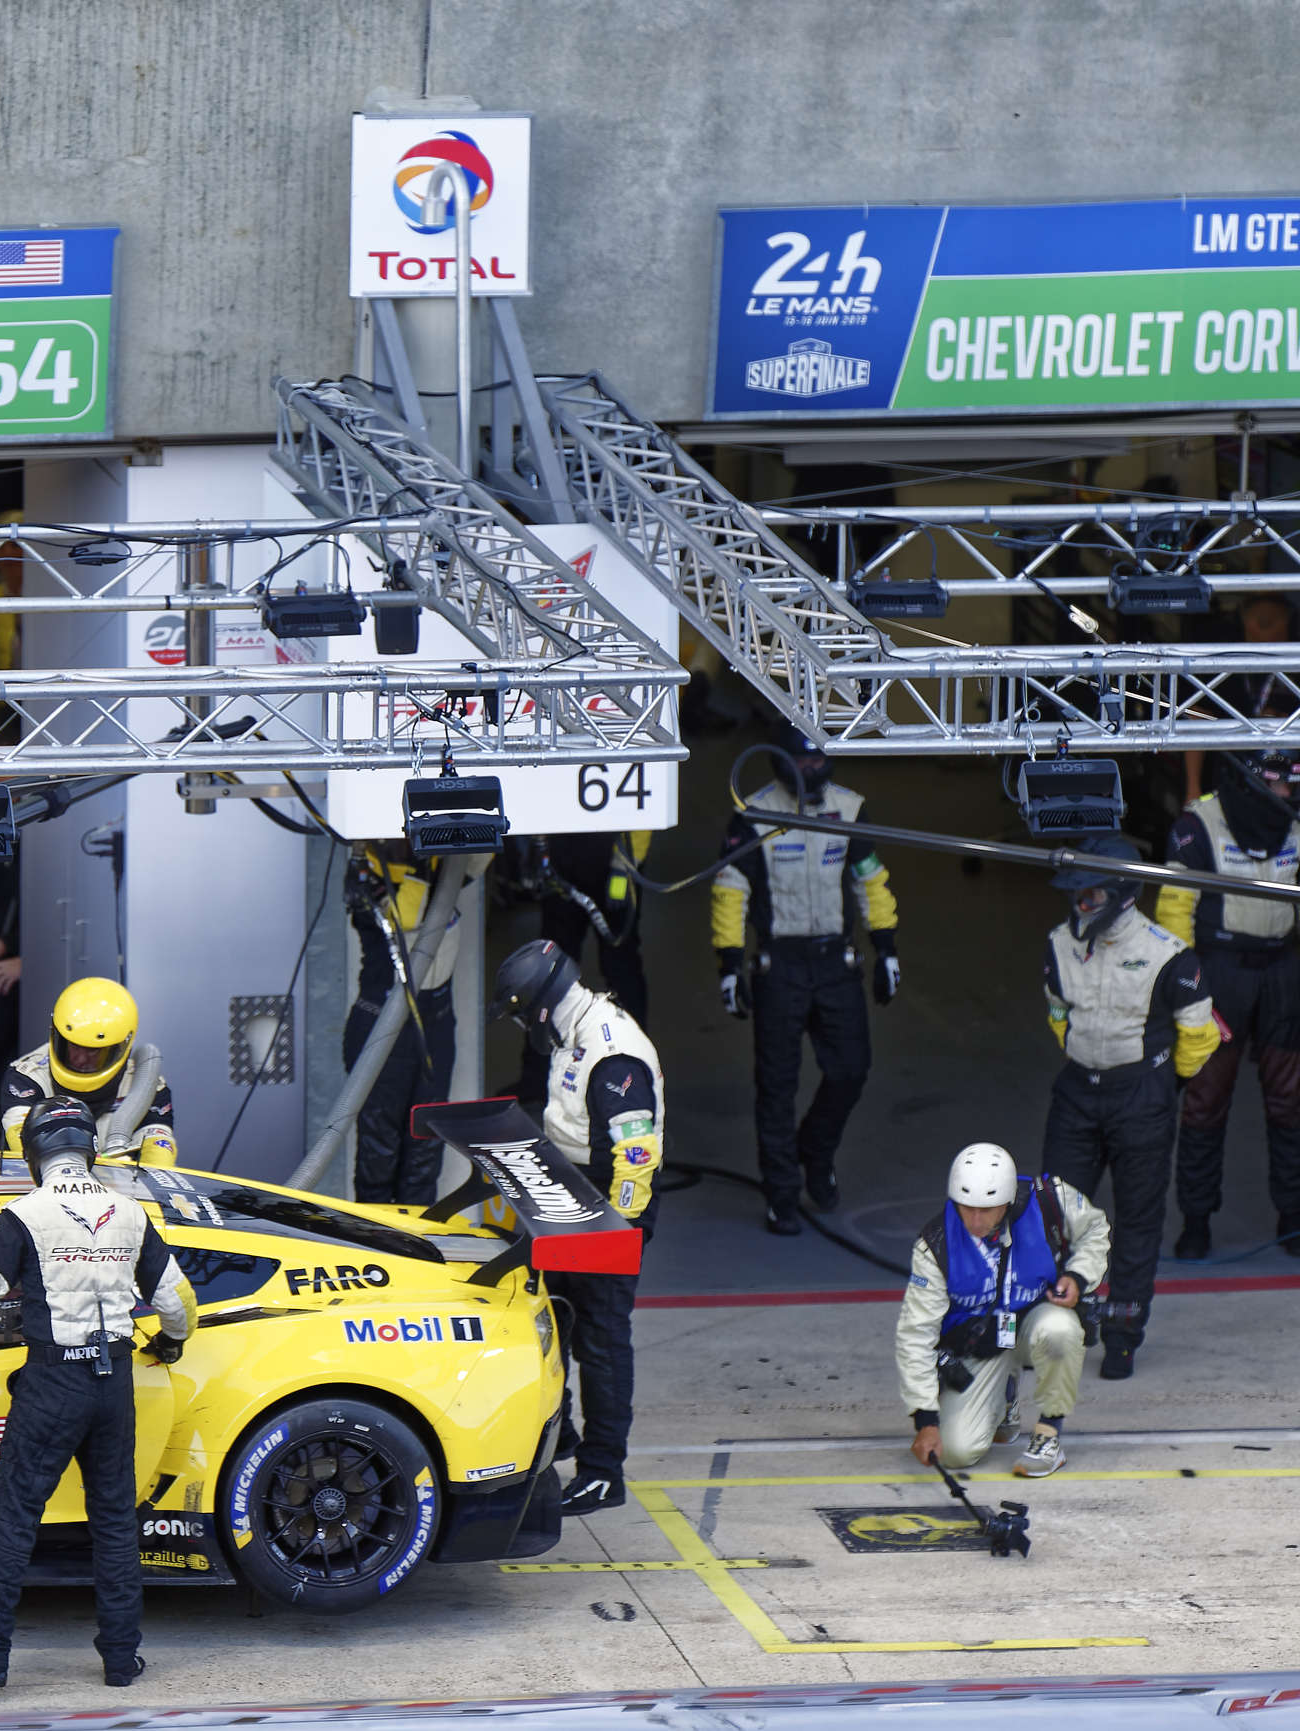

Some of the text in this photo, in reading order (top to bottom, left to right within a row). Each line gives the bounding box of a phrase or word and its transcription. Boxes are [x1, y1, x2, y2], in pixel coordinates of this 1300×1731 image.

[1192, 212, 1300, 253] LM GTE
[367, 251, 516, 280] TOTAL
[752, 230, 882, 295] 24h
[745, 296, 872, 316] LE MANS
[928, 309, 1184, 383] CHEVROLET
[748, 353, 869, 394] SUPERFINALE
[576, 763, 653, 811] 64
[53, 1182, 109, 1195] MARIN
[51, 1246, 135, 1255] CORVETTE
[51, 1254, 131, 1263] RACING
[284, 1263, 390, 1296] FARO
[343, 1316, 444, 1343] Mobil
[233, 1429, 284, 1513] MICHELIN
[385, 1504, 434, 1588] MICHELIN
